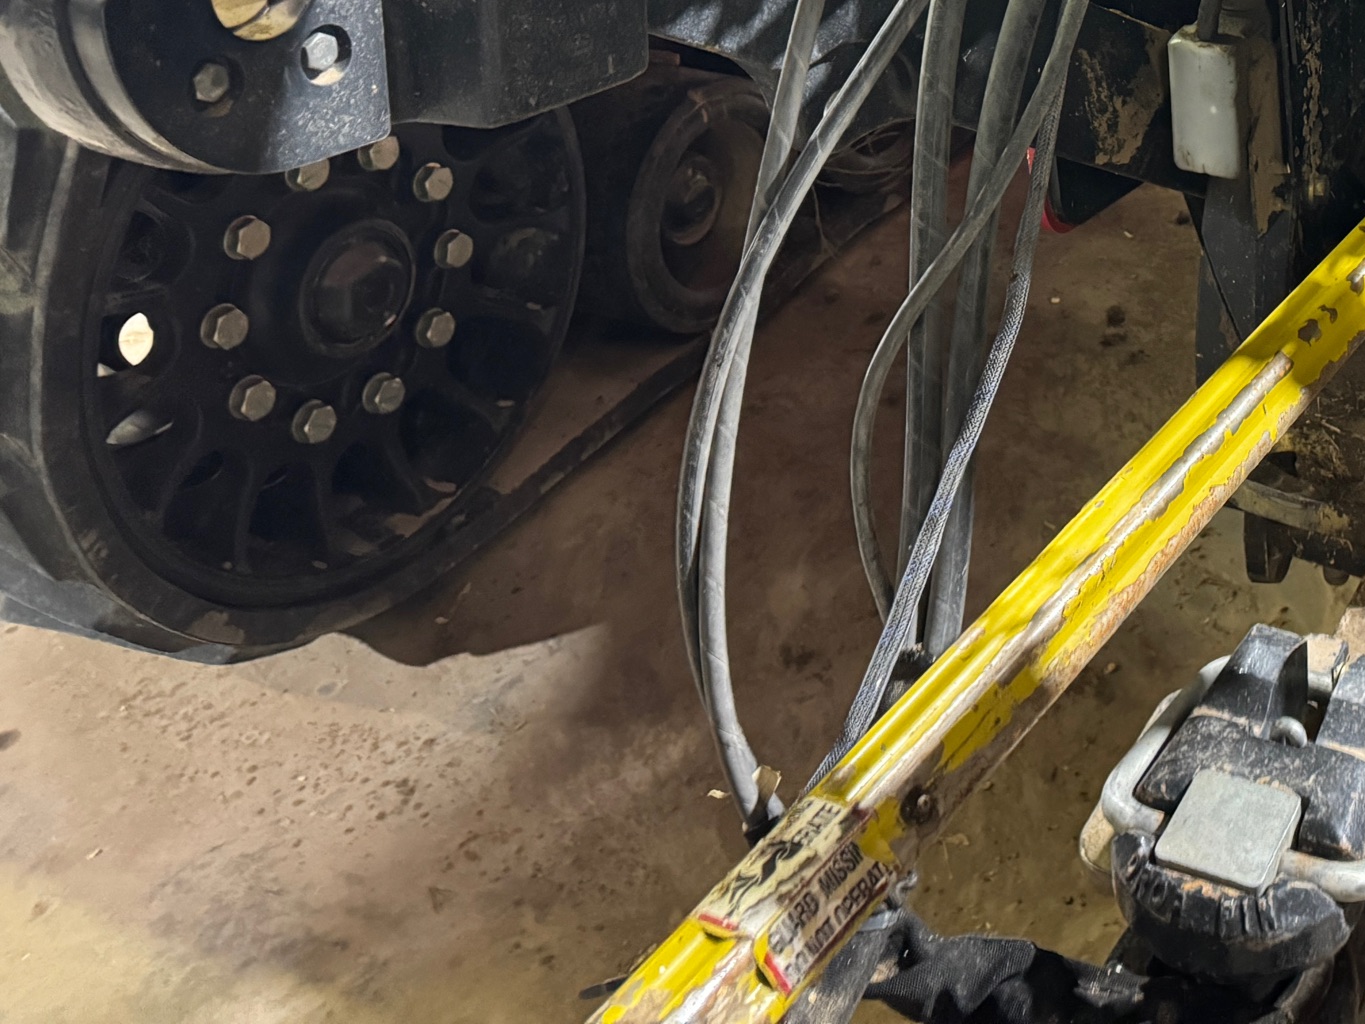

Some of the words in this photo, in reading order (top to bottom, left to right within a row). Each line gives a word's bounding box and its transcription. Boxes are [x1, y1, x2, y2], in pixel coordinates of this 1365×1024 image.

[768, 891, 820, 955] GUARD
[818, 841, 864, 899] MISSIN
[805, 917, 836, 957] NOT
